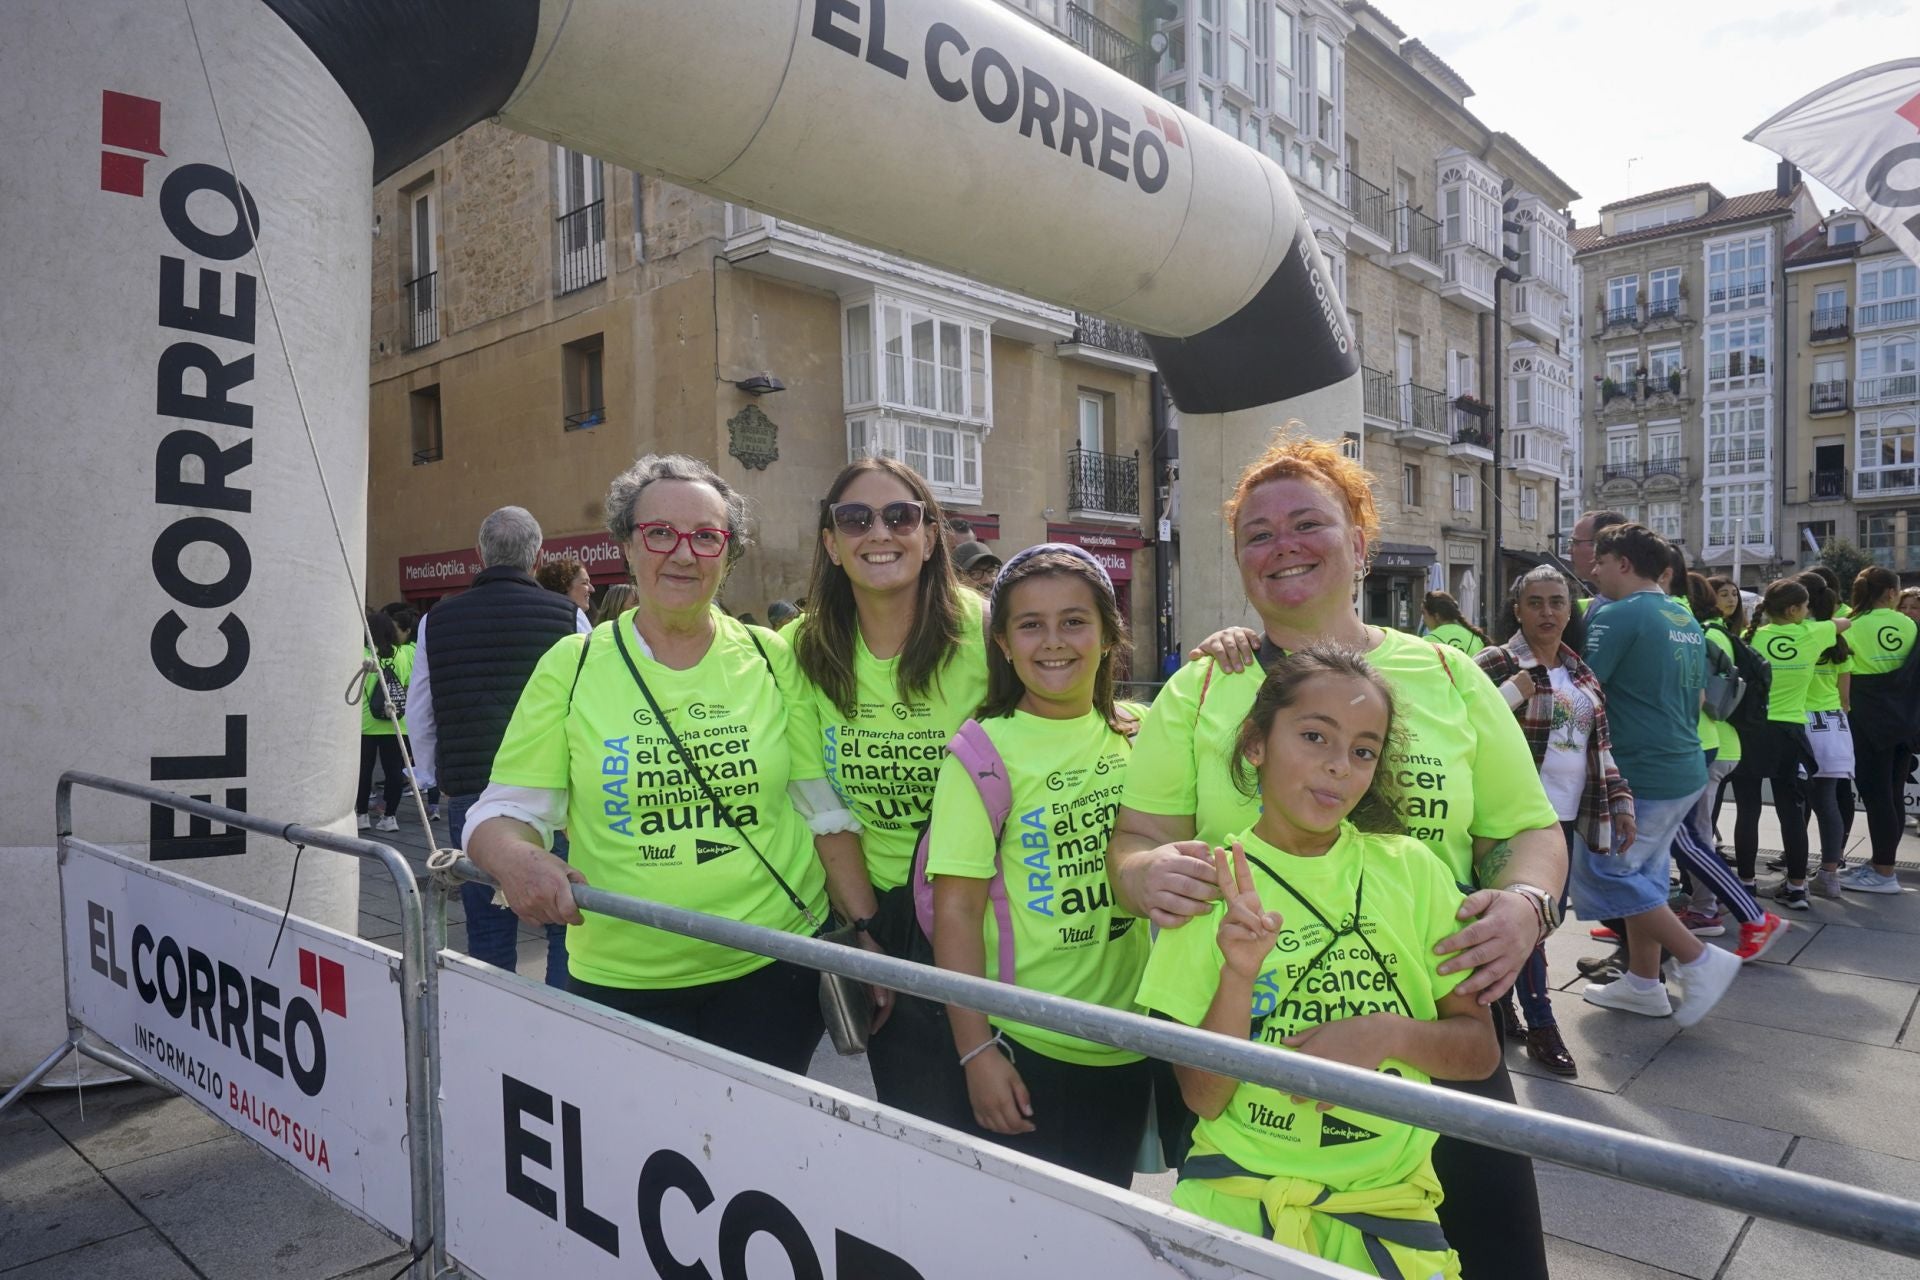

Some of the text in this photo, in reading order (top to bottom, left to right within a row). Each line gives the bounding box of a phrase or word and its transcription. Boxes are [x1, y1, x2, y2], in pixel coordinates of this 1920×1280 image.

[812, 0, 1170, 194] EL CORREO
[1298, 238, 1348, 354] EL CORREO
[150, 162, 260, 862] EL CORREO
[581, 543, 621, 566] Optika
[406, 564, 436, 580] Mendia
[436, 561, 465, 580] Optika
[1668, 629, 1703, 646] ALONSO
[635, 734, 653, 746] En
[703, 723, 749, 739] contra
[841, 725, 946, 740] En marcha contra
[636, 745, 662, 765] el
[841, 738, 947, 761] el cáncer
[601, 734, 635, 838] ARABA
[640, 802, 760, 837] aurka
[1052, 802, 1069, 815] En
[1053, 811, 1078, 836] el
[638, 844, 677, 861] Vital
[1056, 823, 1113, 860] mart
[1020, 806, 1055, 918] ARABA
[1058, 924, 1096, 944] Vital
[1286, 964, 1306, 979] En
[1306, 964, 1398, 995] cáncer
[87, 899, 327, 1098] EL CORREO
[134, 1022, 331, 1174] INFORMAZIO BALIOTSUA
[1247, 1101, 1296, 1131] Vital
[502, 1073, 620, 1258] EL
